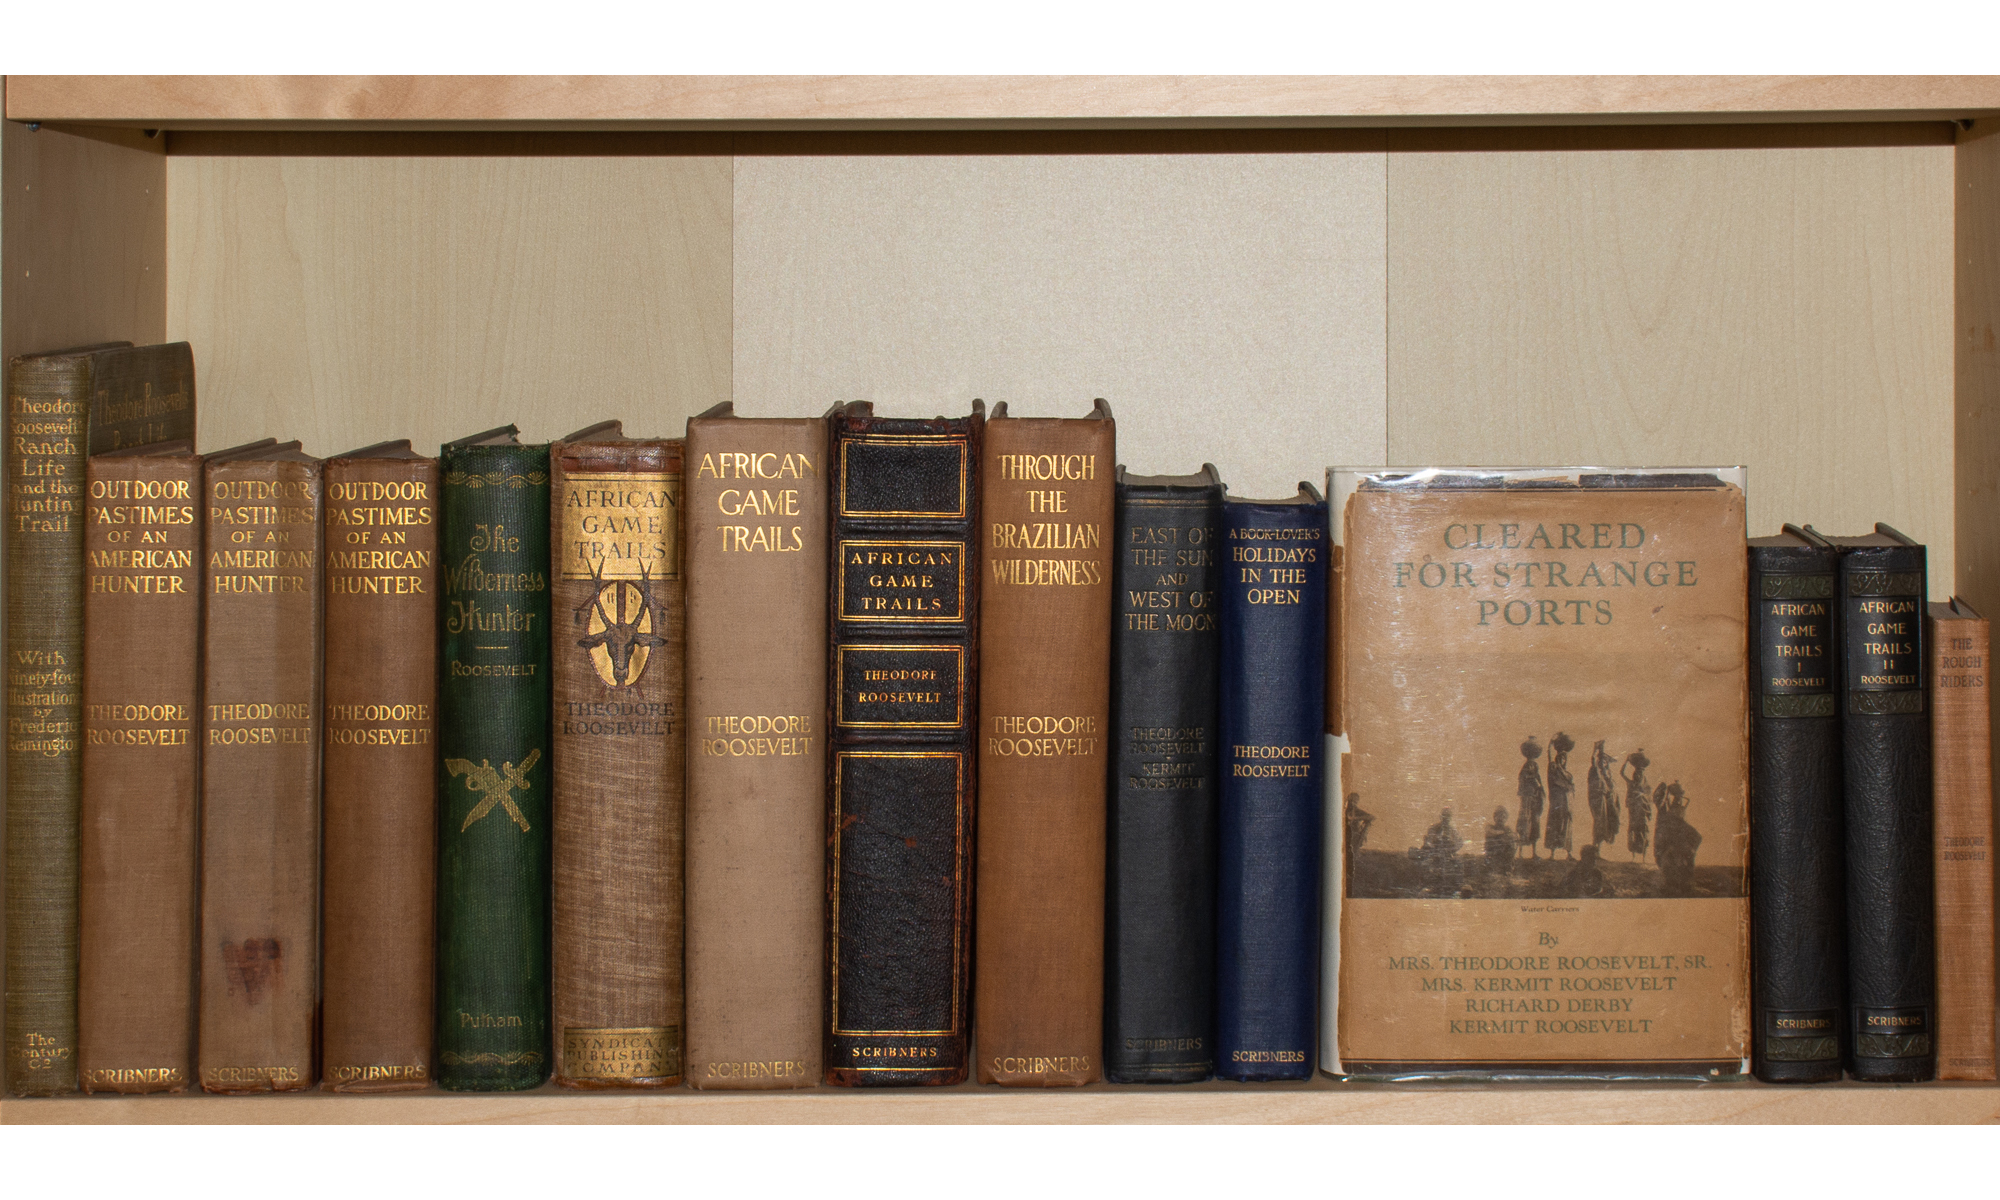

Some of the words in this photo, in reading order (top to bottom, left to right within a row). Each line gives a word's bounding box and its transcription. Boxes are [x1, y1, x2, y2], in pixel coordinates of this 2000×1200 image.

[12, 436, 79, 455] Ranch
[22, 459, 65, 476] Life
[697, 452, 820, 479] AFRICAN
[998, 454, 1095, 480] THROUGH
[12, 479, 46, 494] and
[50, 479, 79, 494] the
[90, 480, 191, 499] OUTDOOR
[214, 481, 313, 500] OUTDOOR
[329, 481, 429, 501] OUTDOOR
[567, 490, 677, 508] AFRICAN
[718, 489, 800, 516] GAME
[1026, 490, 1068, 513] THE
[15, 514, 71, 532] Trail
[88, 506, 194, 525] PASTIMES
[210, 506, 314, 525] PASTIMES
[325, 507, 432, 526] PASTIMES
[582, 515, 662, 534] GAME
[107, 530, 132, 543] OF
[141, 530, 168, 543] AN
[231, 530, 256, 543] OF
[264, 530, 290, 543] AN
[346, 531, 371, 544] OF
[380, 531, 406, 544] AN
[470, 523, 520, 553] The
[716, 525, 803, 552] TRAILS
[992, 523, 1100, 549] BRAZILIAN
[1131, 526, 1182, 544] EAST
[1188, 526, 1214, 545] OF
[1229, 529, 1237, 540] A
[1240, 528, 1320, 541] BOOK-LOVER'S
[1443, 522, 1646, 550] CLEARED
[88, 550, 192, 568] AMERICAN
[210, 550, 313, 568] AMERICAN
[574, 541, 667, 560] TRAILS
[851, 552, 952, 565] AFRICAN
[1130, 549, 1168, 567] THE
[1176, 549, 1213, 567] SUN
[1232, 547, 1317, 563] HOLIDAYS
[326, 550, 431, 569] AMERICAN
[442, 553, 545, 596] Wilderness
[869, 574, 934, 588] GAME
[991, 559, 1101, 586] WILDERNESS
[1156, 572, 1188, 586] AND
[1241, 568, 1262, 583] IN
[1269, 568, 1306, 584] THE
[1392, 560, 1479, 588] FOR
[1493, 560, 1699, 588] STRANGE
[91, 575, 187, 594] HUNTER
[214, 575, 309, 594] HUNTER
[331, 576, 427, 594] HUNTER
[861, 597, 942, 611] TRAILS
[1129, 591, 1183, 609] WEST
[1190, 591, 1214, 609] OF
[1247, 588, 1301, 605] OPEN
[1477, 600, 1613, 626] PORTS
[1771, 604, 1825, 616] AFRICAN
[1859, 601, 1914, 613] AFRICAN
[446, 600, 536, 634] Hunter
[1125, 613, 1160, 631] THE
[1166, 613, 1217, 631] MOON
[1780, 625, 1817, 637] GAME
[1867, 622, 1907, 635] GAME
[1775, 645, 1823, 657] TRAILS
[1863, 642, 1912, 655] TRAILS
[1951, 637, 1973, 650] THE
[16, 650, 67, 665] With
[1883, 659, 1894, 670] II
[1942, 656, 1982, 669] ROUGH
[864, 669, 938, 681] THEODORE
[1772, 677, 1825, 687] ROOSEVELT
[1860, 674, 1916, 684] ROOSEVELT
[1940, 675, 1984, 688] RIDERS
[859, 692, 941, 703] ROOSEVELT
[33, 707, 53, 719] by
[87, 704, 189, 721] THEODORE
[208, 703, 312, 721] THEODORE
[329, 704, 431, 721] THEODORE
[563, 701, 675, 717] THEODORE
[563, 721, 675, 736] ROOSEVELT
[704, 715, 811, 734] THEODORE
[991, 716, 1096, 734] THEODORE
[86, 728, 190, 745] ROOSEVELT
[208, 727, 312, 745] ROOSEVELT
[329, 728, 432, 745] ROOSEVELT
[1131, 727, 1204, 740] THEODORE
[701, 737, 812, 756] ROOSEVELT
[989, 737, 1098, 756] ROOSEVELT
[1129, 742, 1205, 755] ROOSEVELT
[1233, 745, 1310, 759] THEODORE
[1143, 763, 1196, 776] KERMIT
[1233, 764, 1310, 778] ROOSEVELT
[1129, 777, 1206, 790] ROOSEVELT
[1944, 836, 1985, 848] THEODORE
[1943, 850, 1986, 861] ROOSEVELT
[1538, 931, 1559, 949] By
[1388, 956, 1434, 970] MRS.
[1439, 956, 1550, 970] THEODORE
[1557, 955, 1680, 973] ROOSEVELT,
[1684, 955, 1712, 969] SR.
[1421, 978, 1467, 991] MRS.
[1474, 977, 1553, 991] KERMIT
[1559, 977, 1678, 991] ROOSEVELT
[1465, 999, 1560, 1012] RICHARD
[1566, 998, 1633, 1012] DERBY
[459, 1012, 523, 1028] Putnam
[1449, 1020, 1529, 1033] KERMIT
[1536, 1019, 1653, 1034] ROOSEVELT
[1776, 1018, 1832, 1029] SCRIBNERS
[1867, 1015, 1922, 1026] SCRIBNERS
[26, 1031, 56, 1046] The
[1125, 1037, 1203, 1051] SCRIBNERS
[852, 1046, 938, 1058] SCRIBNERS
[1232, 1051, 1305, 1062] SCRIBNERS
[329, 1063, 427, 1081] SCRIBNERS
[707, 1060, 805, 1078] SCRIBNERS
[993, 1056, 1090, 1074] SCRIBNERS
[84, 1065, 182, 1085] SCRIBNERS
[207, 1065, 299, 1083] SCRIBNERS
